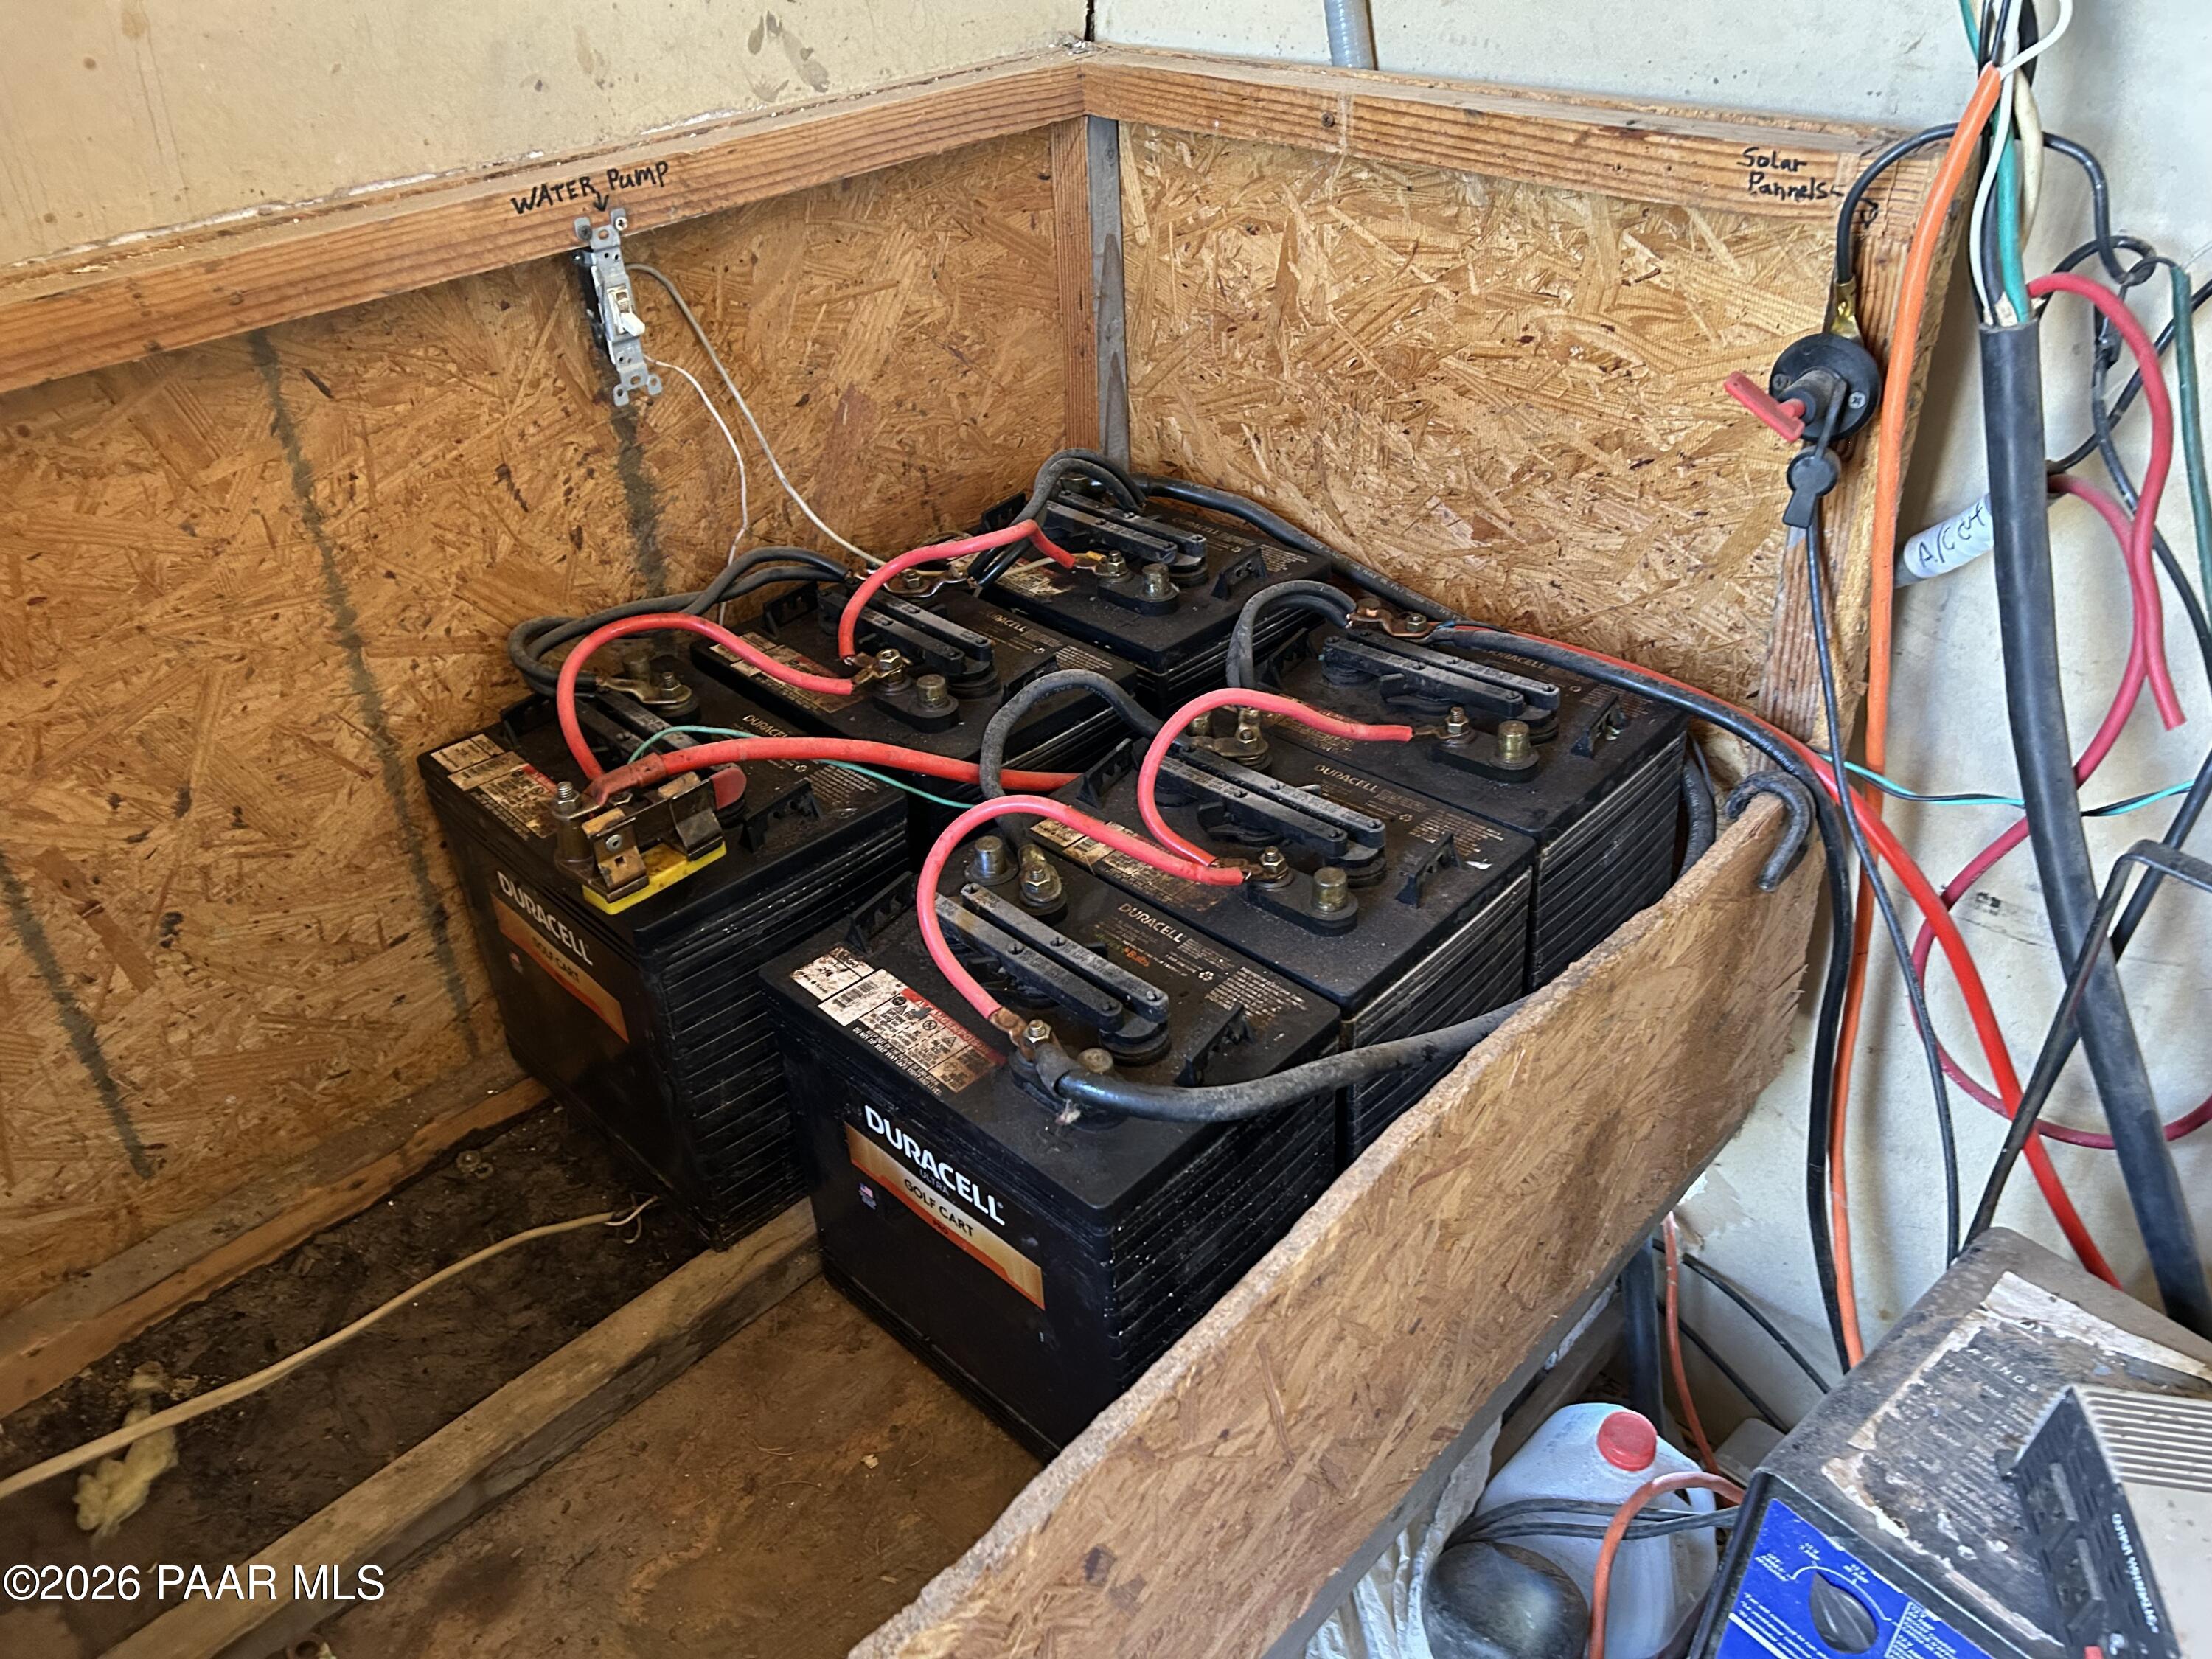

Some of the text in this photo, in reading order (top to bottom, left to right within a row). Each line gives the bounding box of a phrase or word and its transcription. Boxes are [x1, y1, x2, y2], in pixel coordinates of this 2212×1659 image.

[1736, 147, 1806, 172] Solar
[509, 176, 597, 214] WATER
[1314, 764, 1379, 793] DURACELL
[497, 870, 593, 966] DURACELL
[1118, 902, 1184, 943] DURACELL
[864, 1105, 1005, 1225] DURACELL
[919, 1169, 950, 1196] ULTRA
[904, 1179, 936, 1208] GOLF
[939, 1206, 973, 1237] CART
[1966, 1349, 2037, 1391] ATINGS
